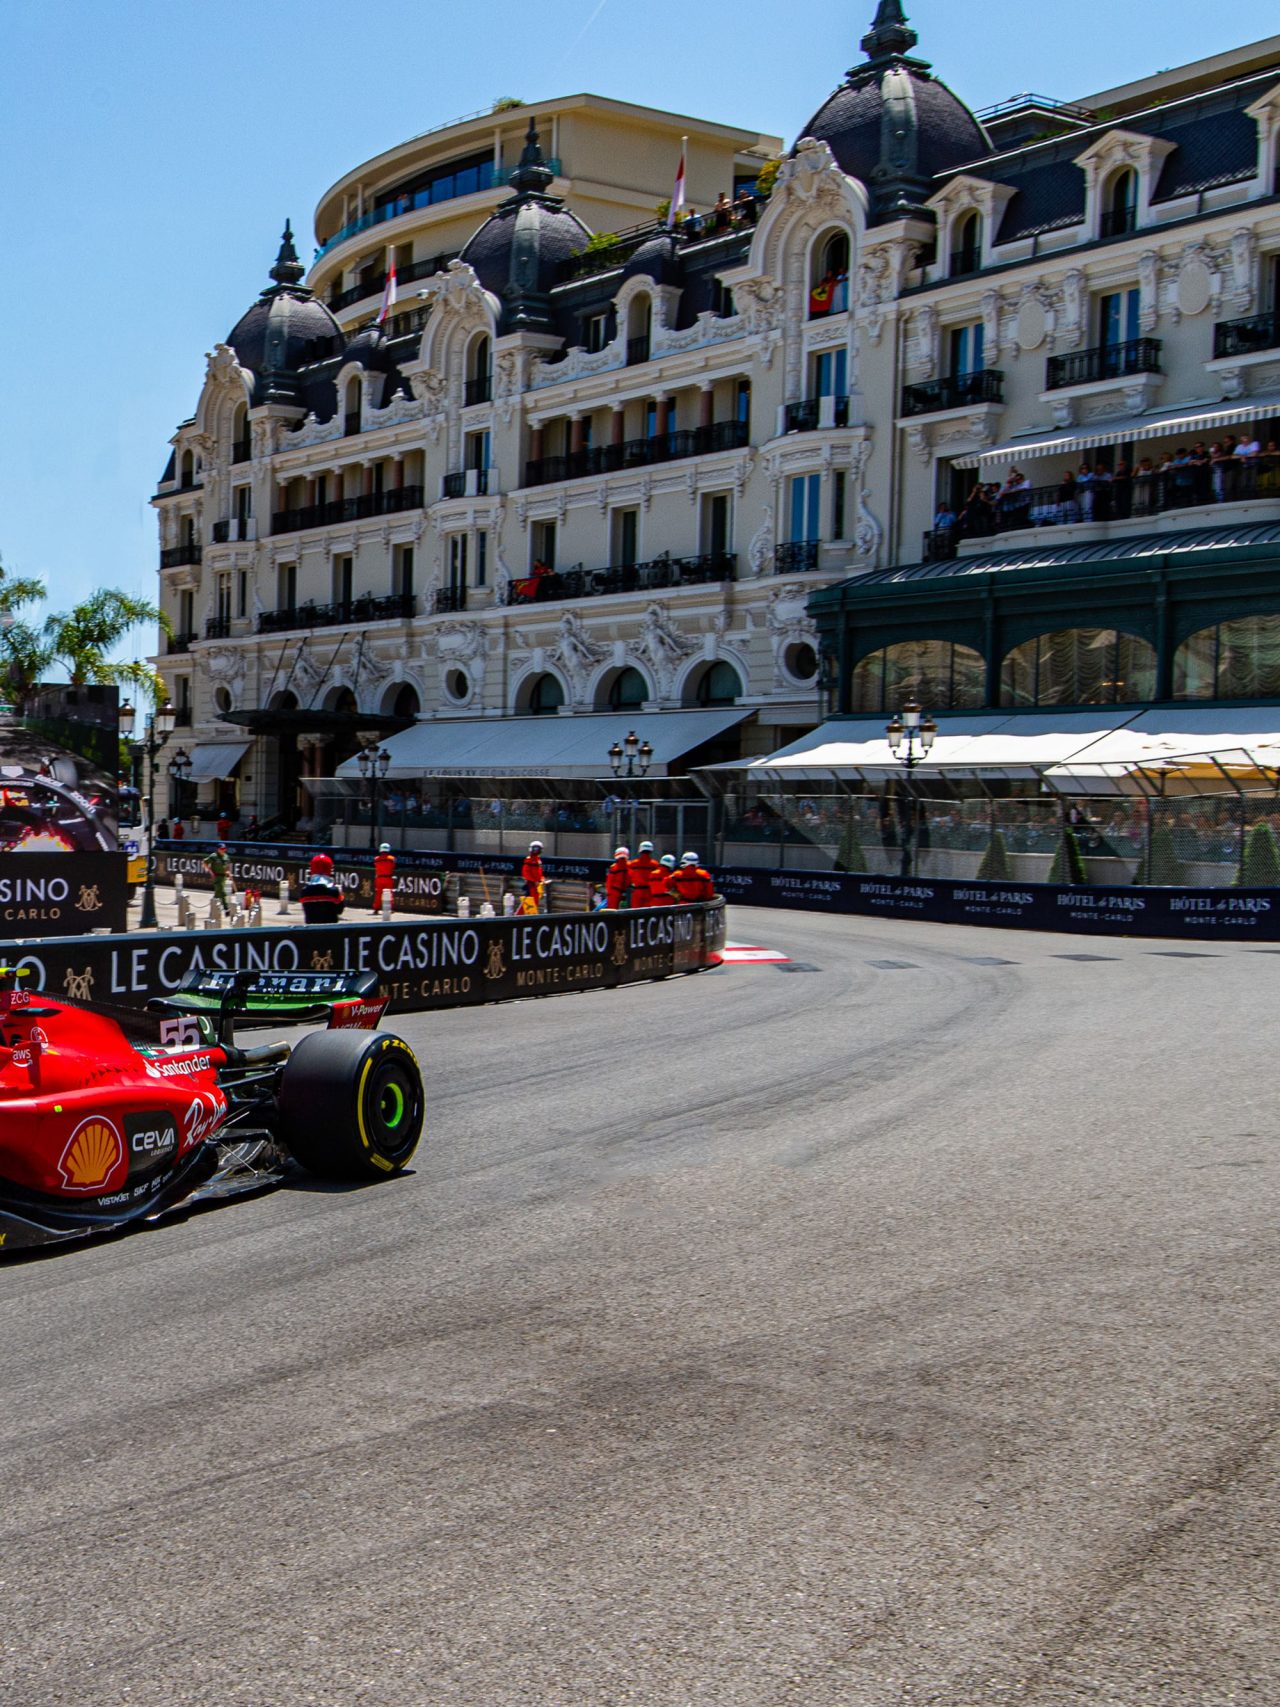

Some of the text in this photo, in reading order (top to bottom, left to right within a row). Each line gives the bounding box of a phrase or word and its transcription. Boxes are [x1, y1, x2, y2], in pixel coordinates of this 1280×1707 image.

[167, 858, 178, 871] LE
[242, 864, 284, 881] CASINO
[393, 876, 441, 895] ASINO
[812, 880, 841, 891] PARIS
[903, 887, 934, 899] PARIS
[1000, 891, 1034, 904] PARIS
[1108, 896, 1145, 911] PARIS
[1228, 898, 1271, 913] PARIS
[630, 919, 645, 948] LE
[647, 913, 693, 946] CASINO
[512, 922, 607, 960] LE CASINO
[343, 929, 478, 971] LE CASINO
[111, 939, 299, 993] LE CASINO
[205, 972, 348, 993] Frrari
[11, 992, 30, 1004] ZCG
[351, 1002, 382, 1017] V-Power
[160, 1016, 200, 1055] 55
[382, 1039, 390, 1050] P
[13, 1049, 31, 1060] aws
[154, 1054, 210, 1077] Santander
[133, 1182, 149, 1197] SKF
